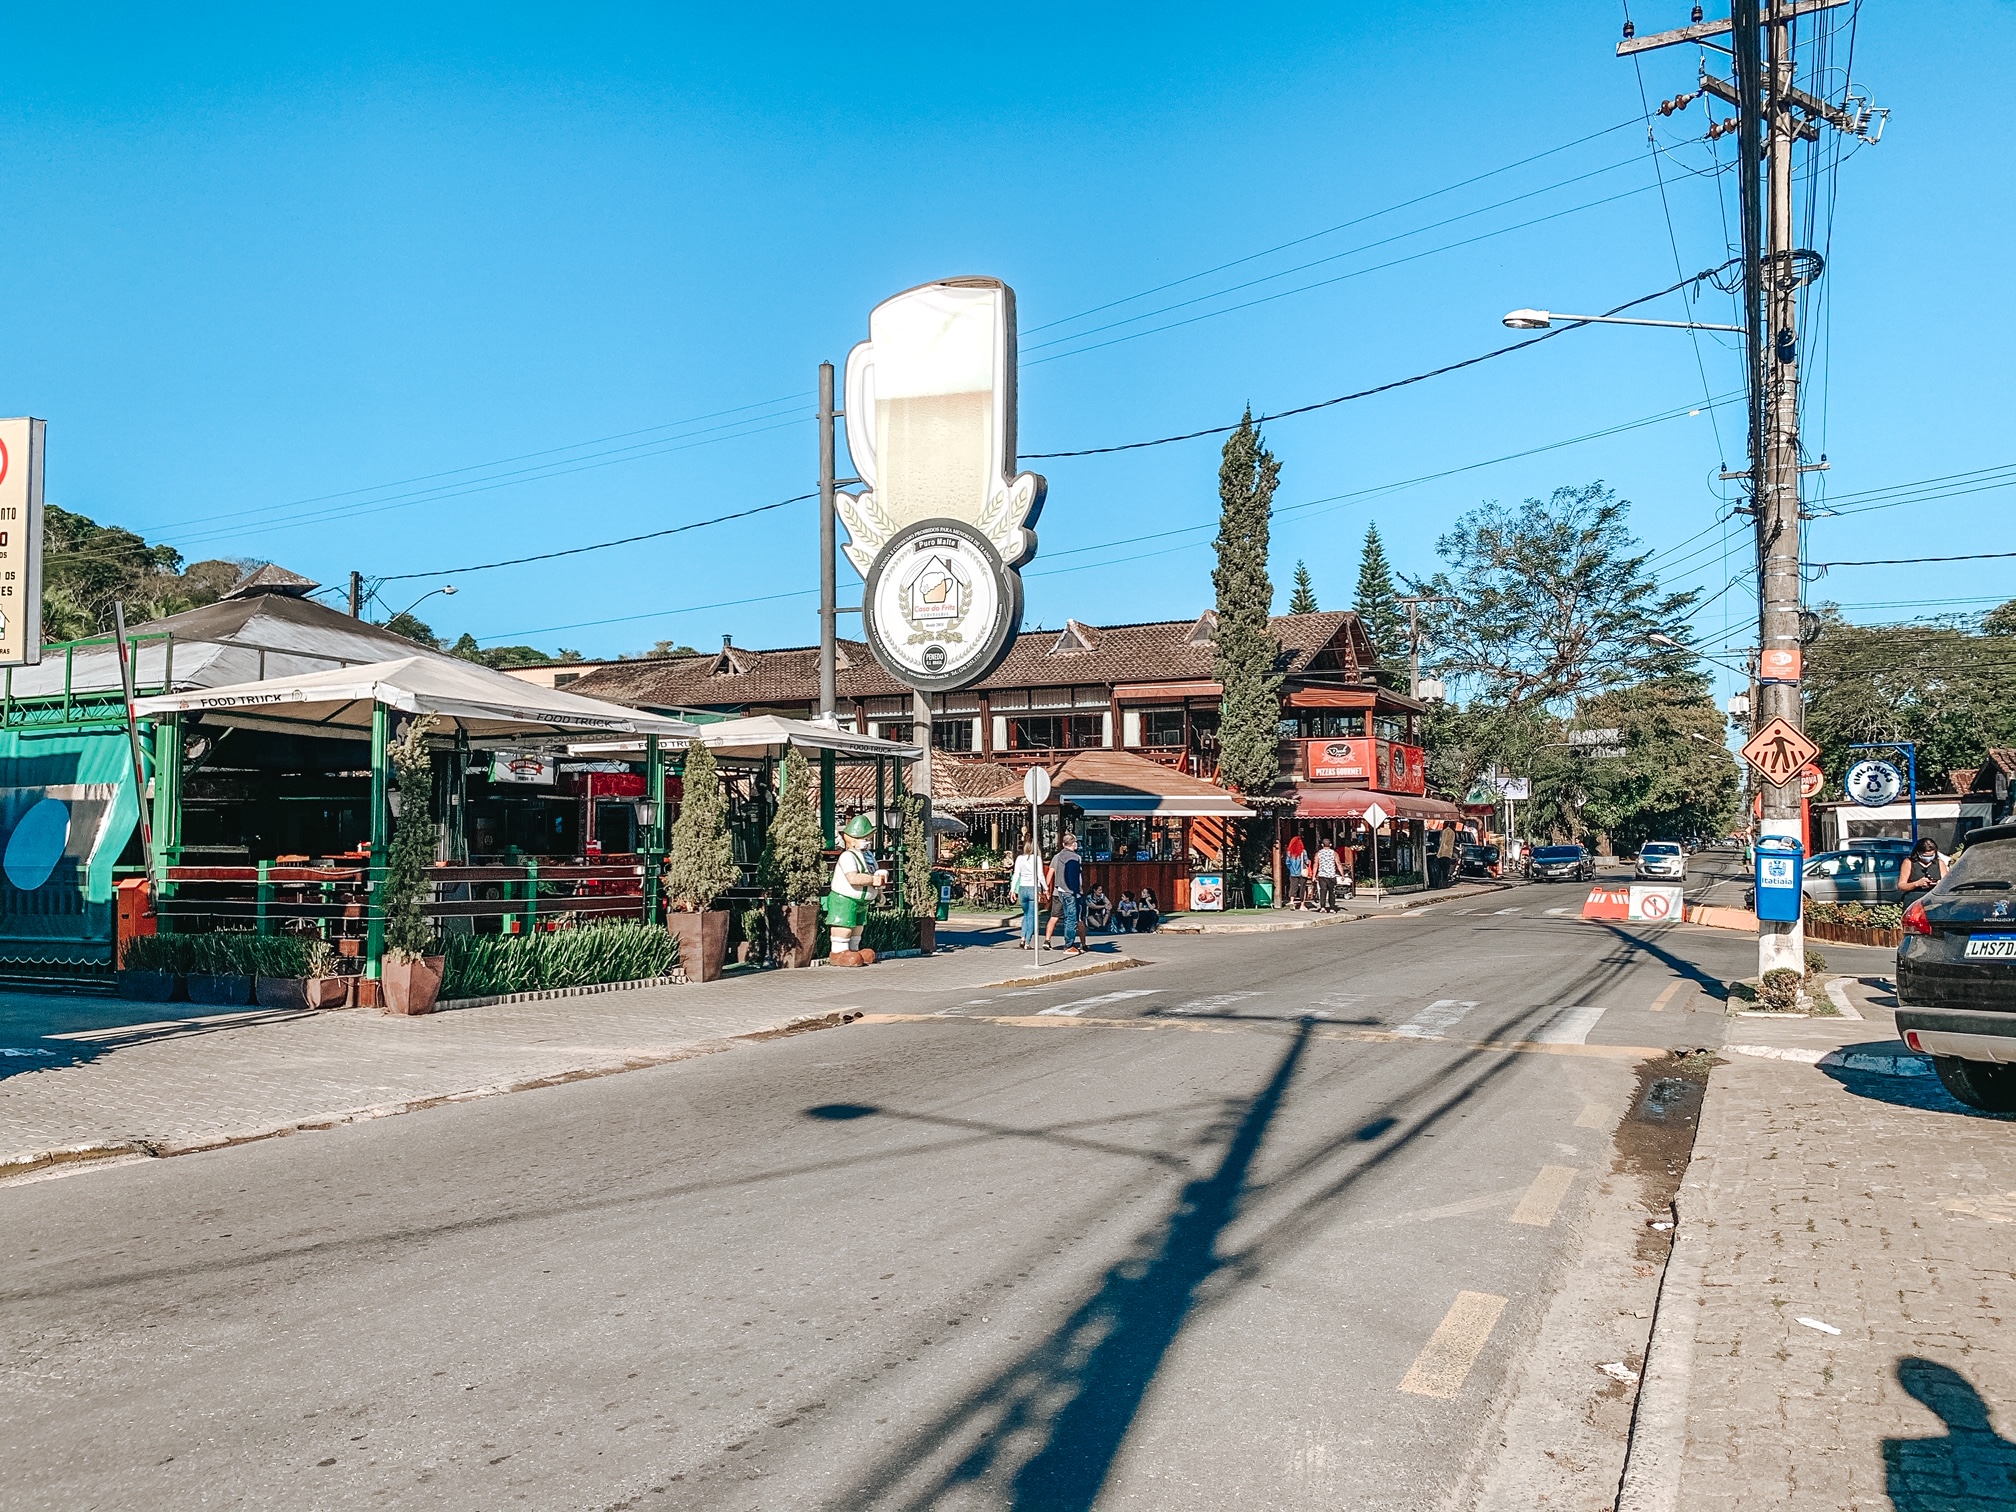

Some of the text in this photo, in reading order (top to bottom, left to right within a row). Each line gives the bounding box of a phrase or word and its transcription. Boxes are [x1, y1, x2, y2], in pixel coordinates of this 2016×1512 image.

[919, 538, 956, 549] Puro Malte
[914, 605, 930, 613] Casa
[925, 652, 944, 661] PENEDO
[200, 693, 282, 707] FOOD TRUCK
[536, 712, 614, 729] FOOD TRUCK
[849, 744, 892, 754] FOOD TRUCK
[1315, 766, 1363, 777] PIZZAS GOURMET
[1761, 877, 1793, 886] Itatiaia
[1970, 942, 2016, 956] LMS7D
